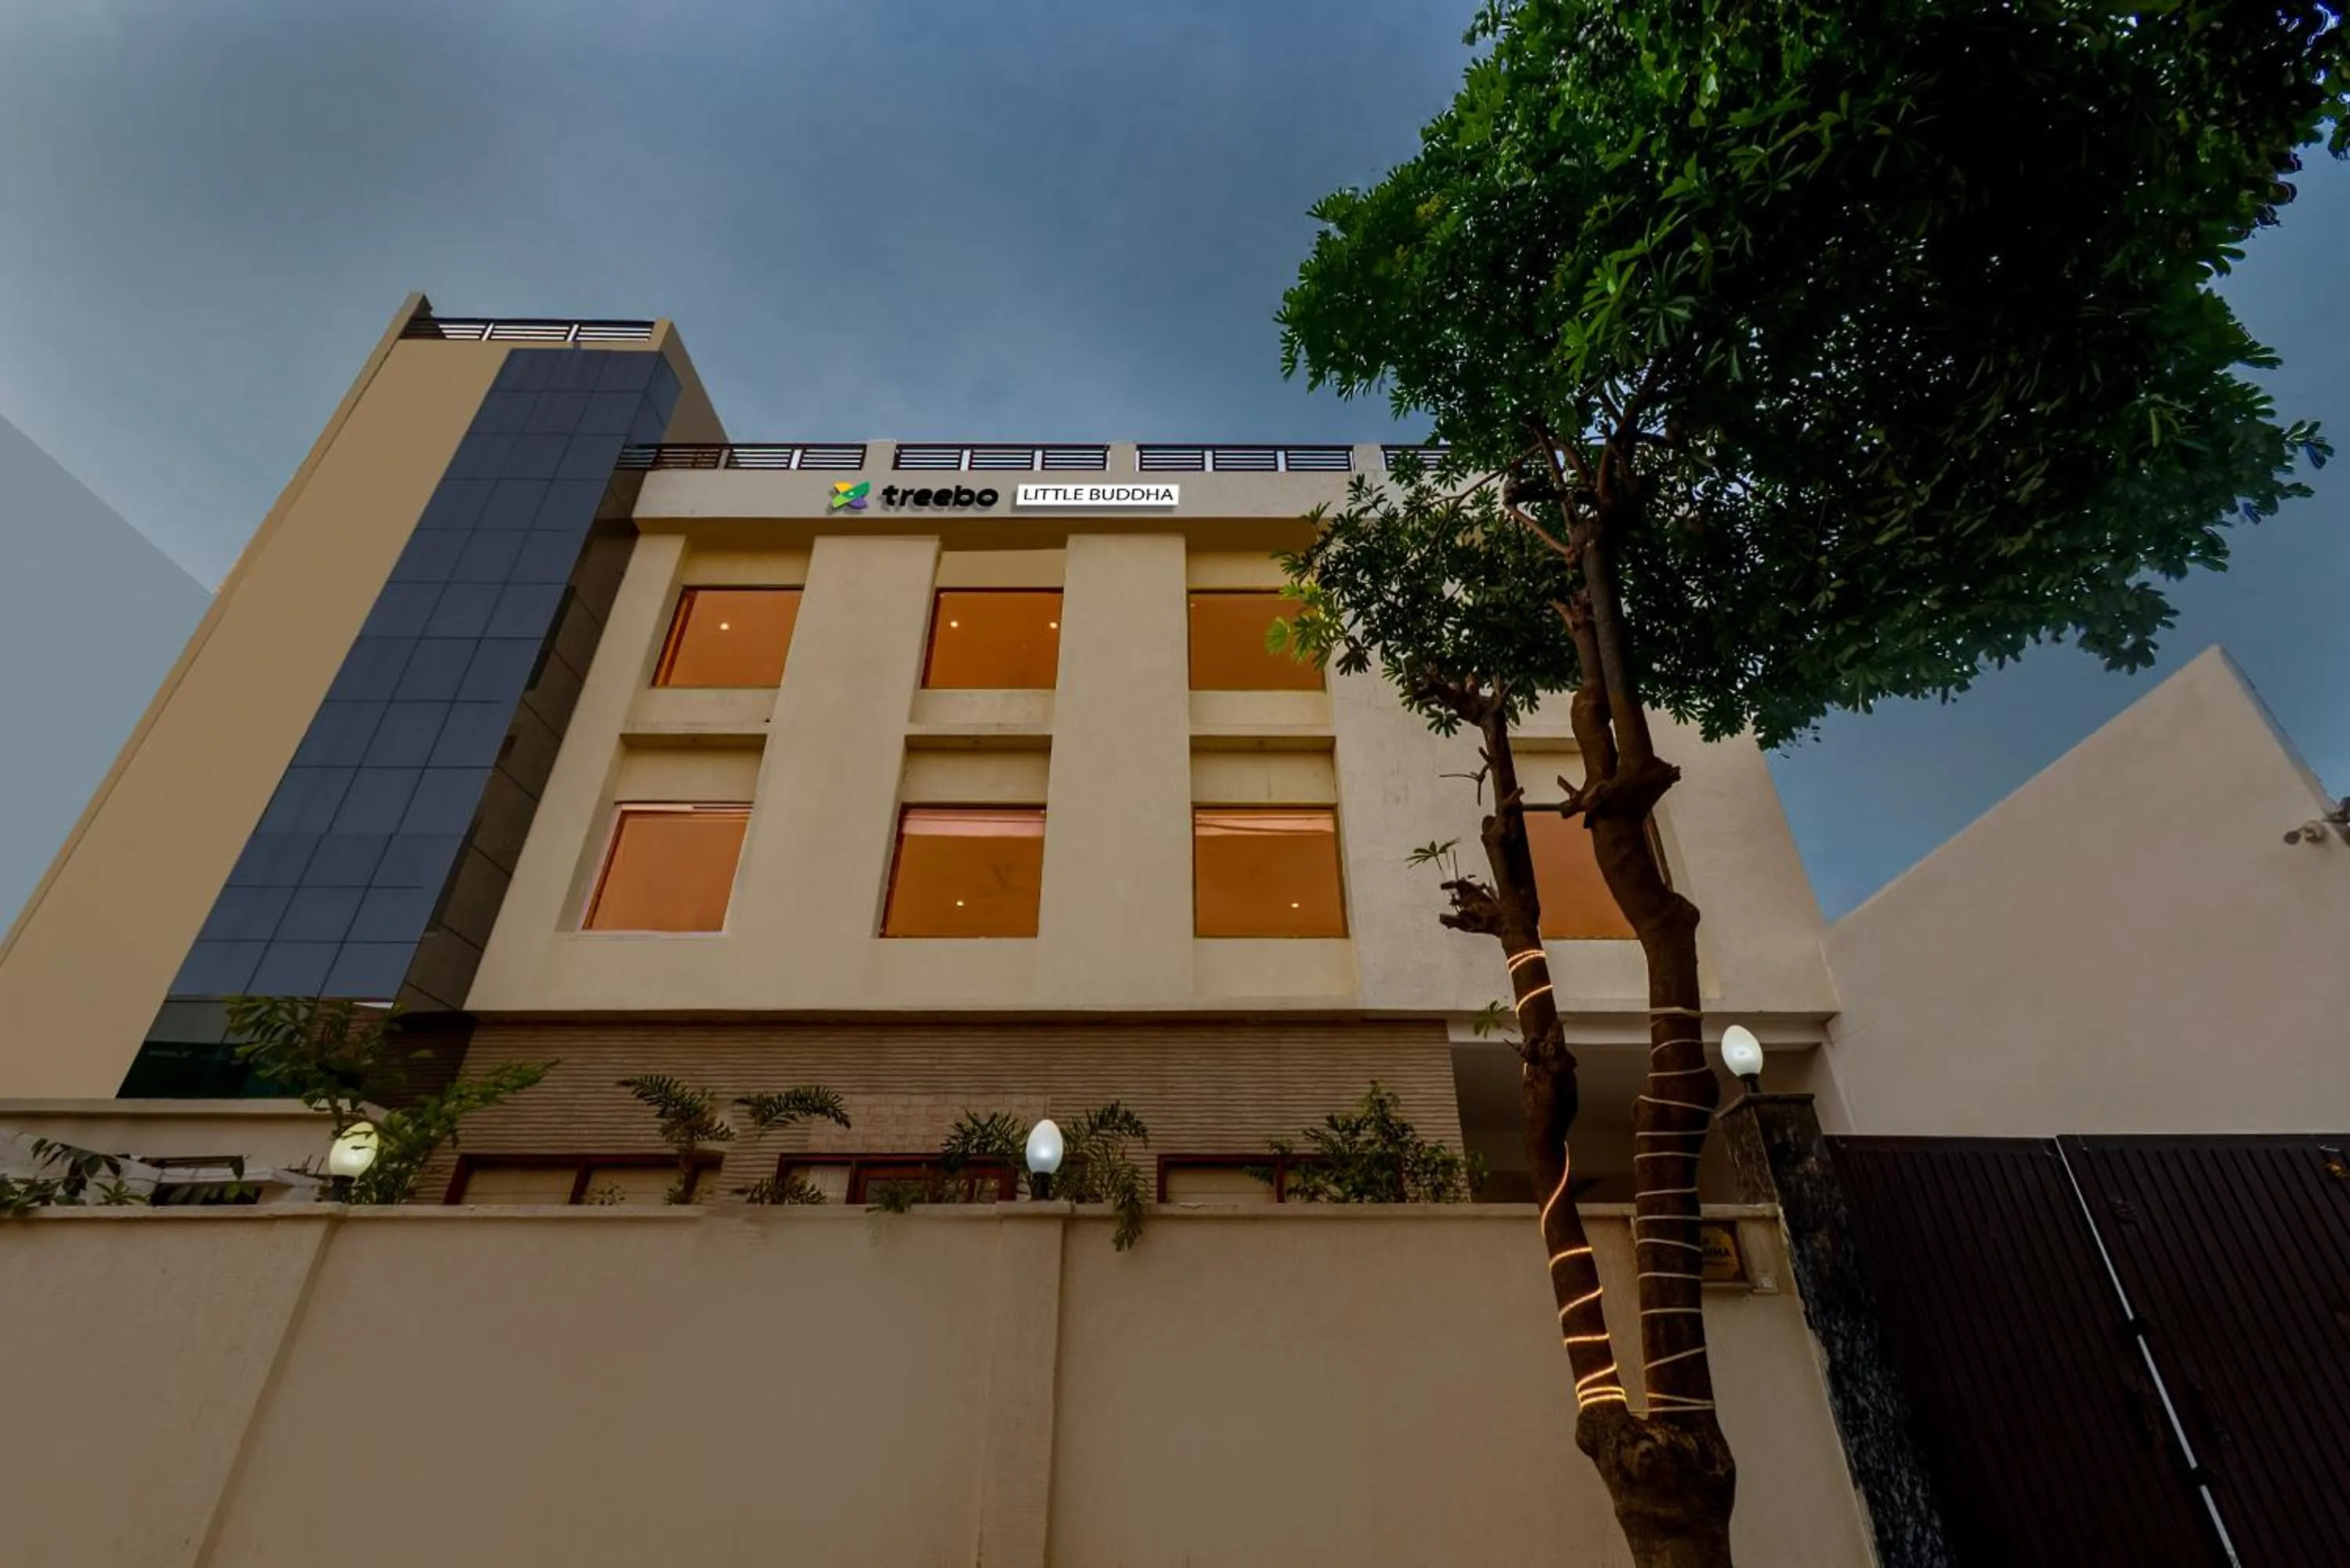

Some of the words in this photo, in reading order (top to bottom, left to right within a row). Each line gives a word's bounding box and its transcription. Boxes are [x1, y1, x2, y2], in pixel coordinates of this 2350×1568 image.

[882, 485, 999, 507] treebo
[1023, 488, 1084, 500] LITTLE
[1089, 488, 1173, 500] BUDDHA
